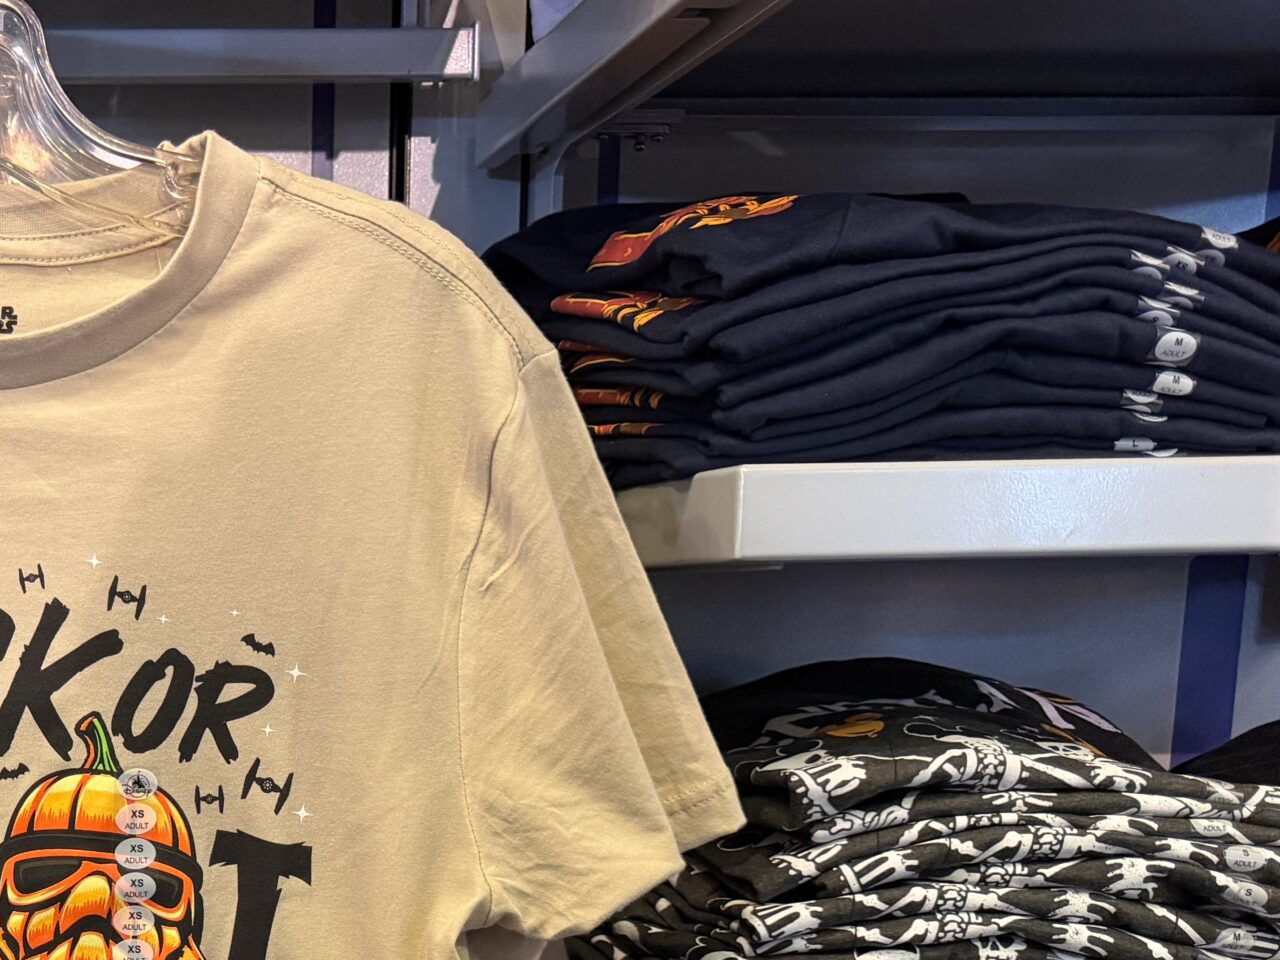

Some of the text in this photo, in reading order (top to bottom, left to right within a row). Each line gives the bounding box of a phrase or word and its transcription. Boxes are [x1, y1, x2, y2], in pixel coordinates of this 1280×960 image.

[1174, 337, 1184, 347] M
[1160, 349, 1186, 358] ADULT
[1172, 375, 1181, 385] M
[111, 647, 276, 765] OR
[130, 809, 145, 819] XS
[124, 822, 150, 830] ADULT
[1202, 824, 1227, 832] ADULT
[129, 844, 144, 853] XS
[124, 856, 149, 865] ADULT
[1232, 859, 1257, 869] ADULT
[130, 878, 145, 888] XS
[123, 891, 149, 899] ADULT
[1244, 888, 1253, 897] S
[128, 911, 143, 920] XS
[122, 923, 147, 932] ADULT
[1232, 932, 1241, 941] M
[127, 945, 142, 954] XS
